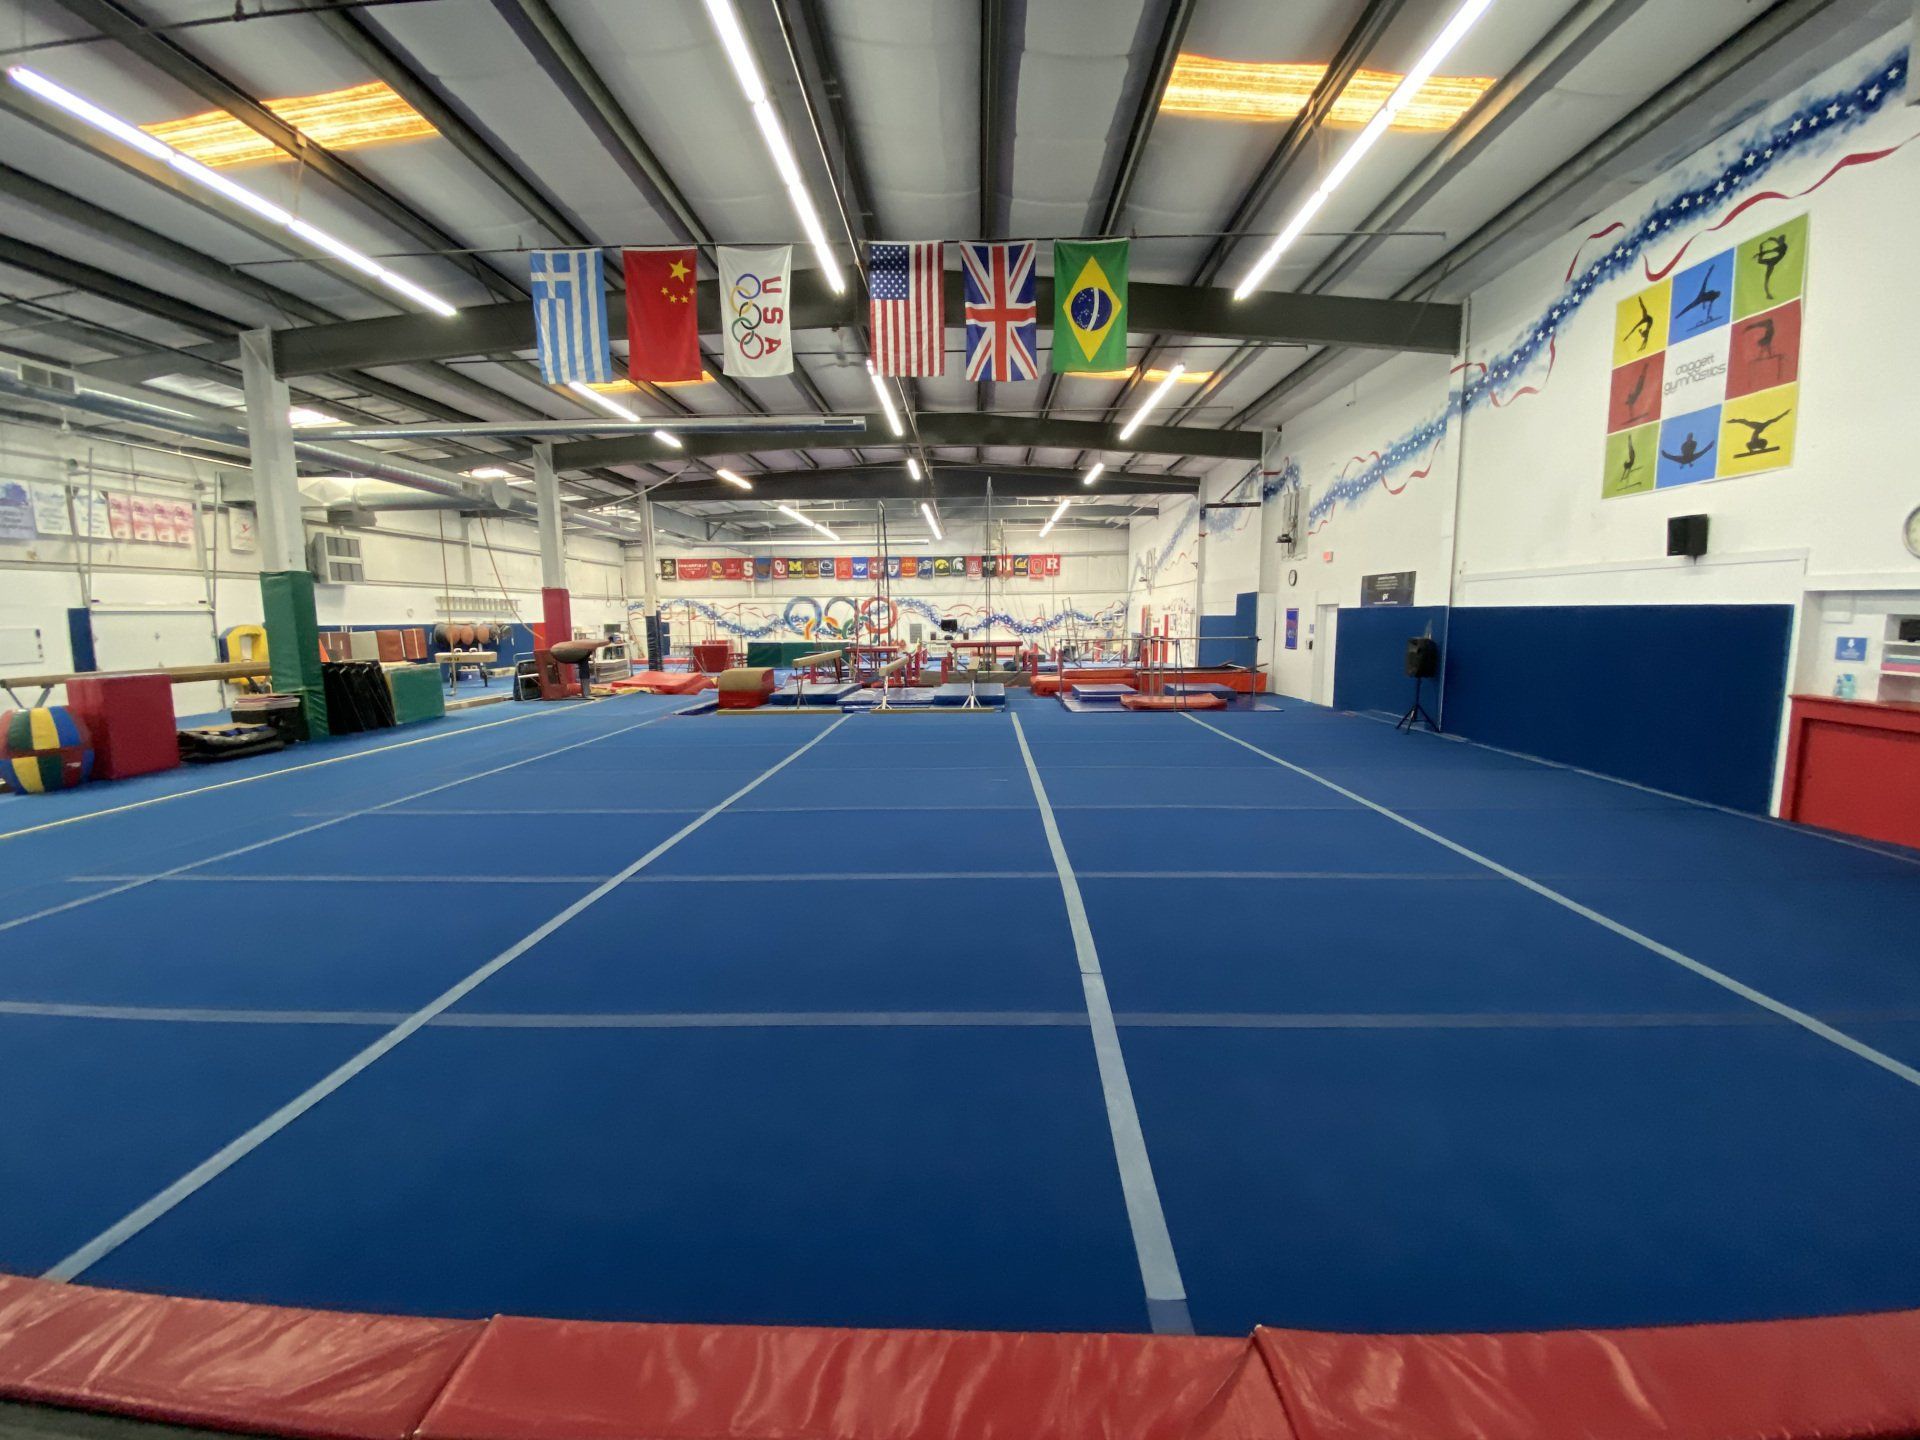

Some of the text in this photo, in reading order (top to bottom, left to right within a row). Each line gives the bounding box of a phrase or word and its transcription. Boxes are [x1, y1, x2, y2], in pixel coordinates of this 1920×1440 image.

[762, 276, 783, 355] USA
[743, 561, 753, 576] S
[788, 561, 802, 571] M
[1046, 558, 1059, 570] R
